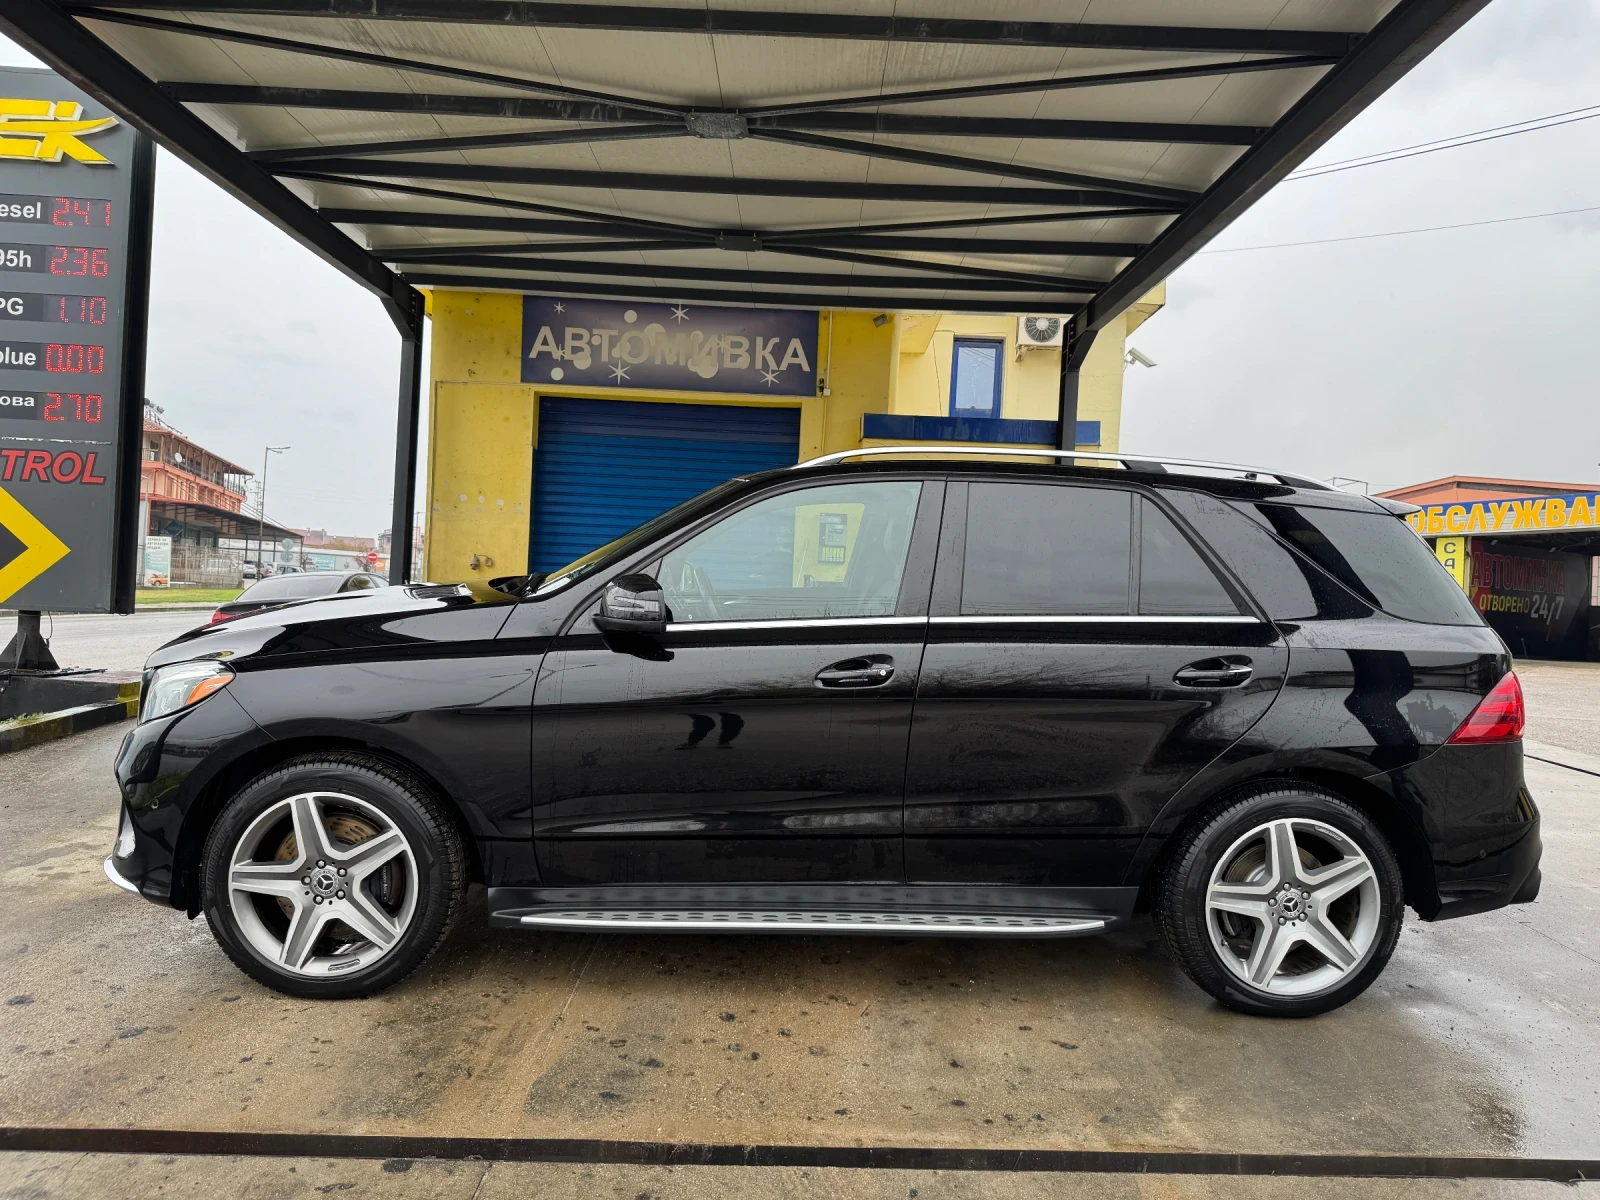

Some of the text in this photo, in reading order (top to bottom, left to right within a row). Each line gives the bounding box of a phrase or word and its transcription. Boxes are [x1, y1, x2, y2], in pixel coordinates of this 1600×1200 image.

[0, 202, 41, 219] esel
[51, 247, 108, 276] 2.36
[528, 325, 811, 373] АВТОМИВКА
[0, 393, 102, 423] ова 2.70
[1, 449, 106, 484] TROL
[1470, 552, 1567, 595] АВТОМИВКА
[1479, 594, 1565, 625] ОТВОРЕНО 24/7
[207, 825, 230, 893] BRIDGESTONE
